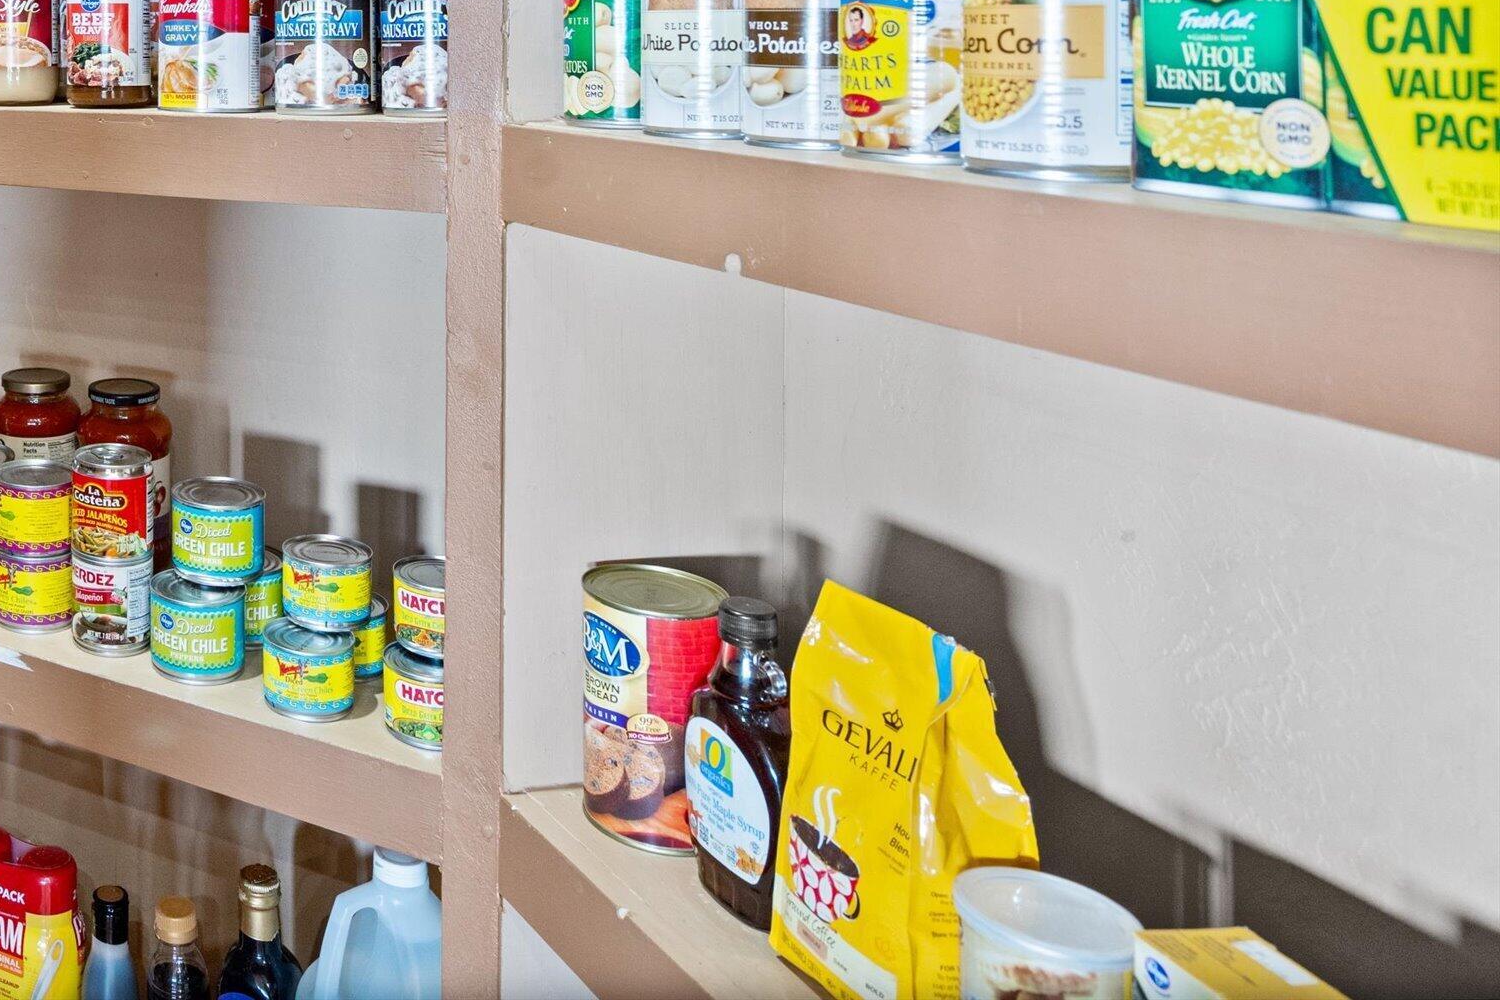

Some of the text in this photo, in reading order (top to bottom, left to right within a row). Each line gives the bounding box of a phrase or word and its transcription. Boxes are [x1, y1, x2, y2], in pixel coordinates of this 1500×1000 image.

[71, 12, 115, 27] BEEF
[164, 24, 199, 33] TURKEY
[748, 20, 789, 32] WHOLE
[1176, 8, 1222, 32] Fresh
[73, 25, 112, 36] GRAVY
[165, 34, 197, 42] GRAVY
[275, 21, 360, 38] SAUSAGE GRAVY
[381, 22, 425, 39] SAUSAGE
[1365, 5, 1473, 56] CAN
[1180, 40, 1257, 69] WHOLE
[585, 82, 604, 91] NON
[1155, 64, 1287, 95] KERNEL CORN
[1386, 67, 1500, 103] VALUE
[175, 93, 198, 101] MORE
[584, 90, 605, 99] GMO
[1275, 120, 1312, 133] NON
[1276, 132, 1314, 146] GMO
[23, 447, 38, 455] Facts
[73, 489, 121, 508] Costeña
[87, 485, 101, 497] La
[86, 508, 129, 529] JALAPEÑOS
[195, 522, 232, 539] Diced
[174, 532, 246, 558] GREEN CHILE
[74, 589, 104, 602] Jalapeños
[246, 603, 278, 621] CHILE
[177, 619, 215, 635] Diced
[600, 620, 618, 635] OVEN
[153, 627, 229, 654] GREEN CHILE
[585, 670, 621, 695] BROWN
[401, 684, 444, 706] HATC
[585, 681, 619, 705] BREAD
[584, 700, 618, 723] RAISIN
[628, 732, 669, 742] NO Cholesterol
[821, 707, 918, 784] GEVALI
[701, 764, 732, 794] organics
[848, 752, 899, 793] KAFFE
[713, 798, 736, 823] Maple
[737, 815, 766, 842] Syrup
[785, 892, 811, 923] Ground
[810, 918, 837, 950] Coffee
[864, 981, 886, 1000] BOLD
